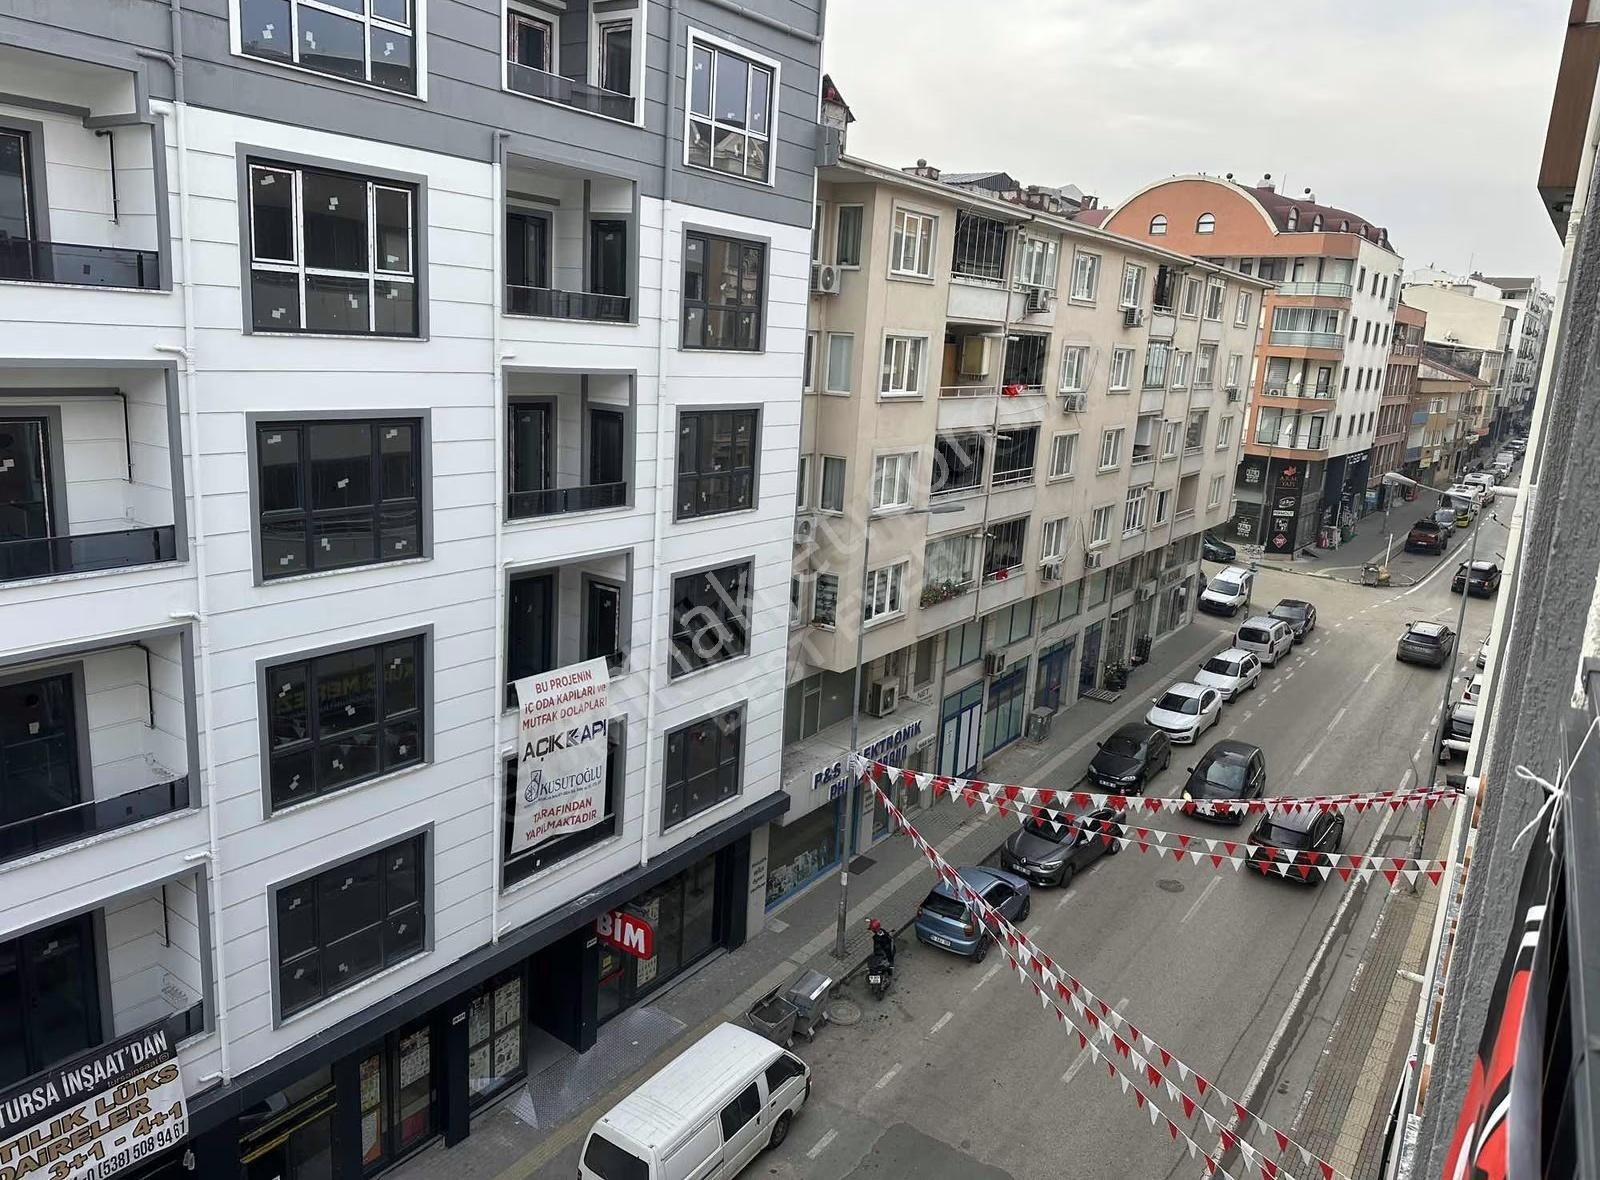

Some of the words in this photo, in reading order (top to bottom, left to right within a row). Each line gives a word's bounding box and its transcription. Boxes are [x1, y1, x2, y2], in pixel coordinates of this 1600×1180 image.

[535, 681, 548, 694] BU
[549, 670, 592, 691] PROJENİN
[536, 698, 555, 711] ODA
[556, 686, 596, 707] KAPILARI
[522, 712, 559, 730] MUTFAK
[560, 697, 607, 719] DOLAPLARI
[812, 761, 842, 791] P&S
[847, 719, 922, 772] EKTRONİK
[525, 810, 597, 841] YAPILMAKTADIR
[533, 797, 593, 822] TARAFINDAN
[597, 911, 645, 954] BİM
[61, 1030, 168, 1091] İNŞAAT'DAN
[95, 1063, 180, 1116] LÜKS
[48, 1140, 106, 1180] 3+1
[132, 1101, 183, 1137] 4+1
[99, 1149, 130, 1180] (538)
[133, 1136, 155, 1160] 508
[157, 1129, 173, 1150] 94
[174, 1121, 186, 1142] 61
